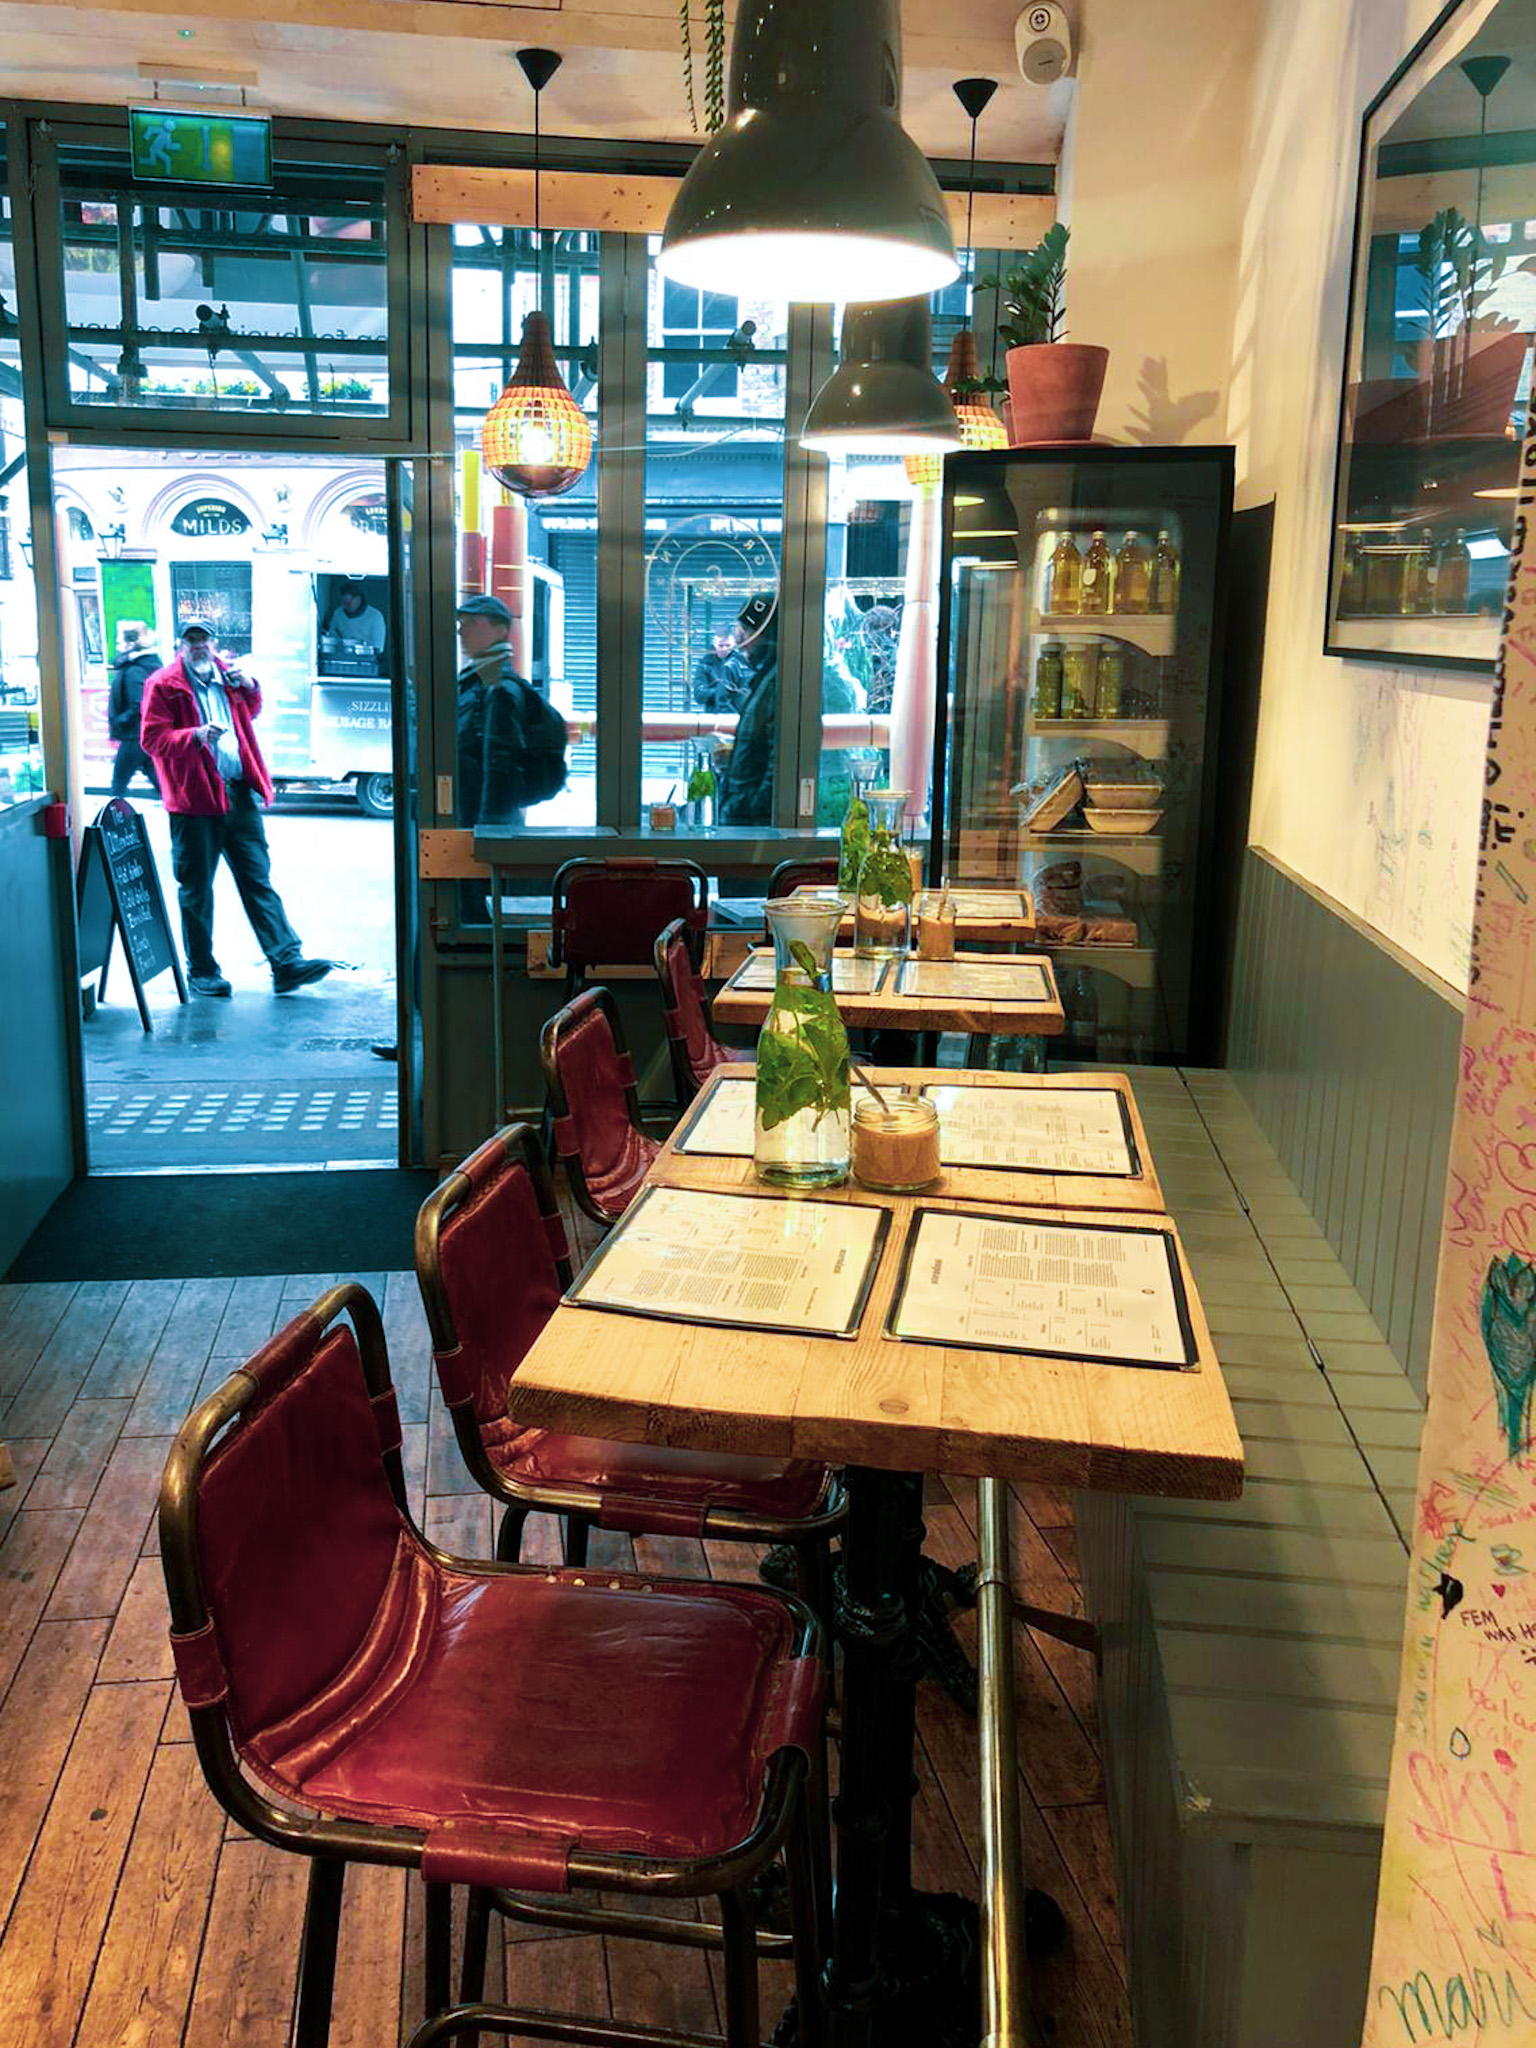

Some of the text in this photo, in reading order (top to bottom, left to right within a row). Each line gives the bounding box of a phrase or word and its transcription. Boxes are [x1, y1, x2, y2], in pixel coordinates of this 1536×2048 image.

[182, 518, 242, 536] MILDS
[1460, 1608, 1500, 1628] FEM
[1483, 1625, 1517, 1642] WAS
